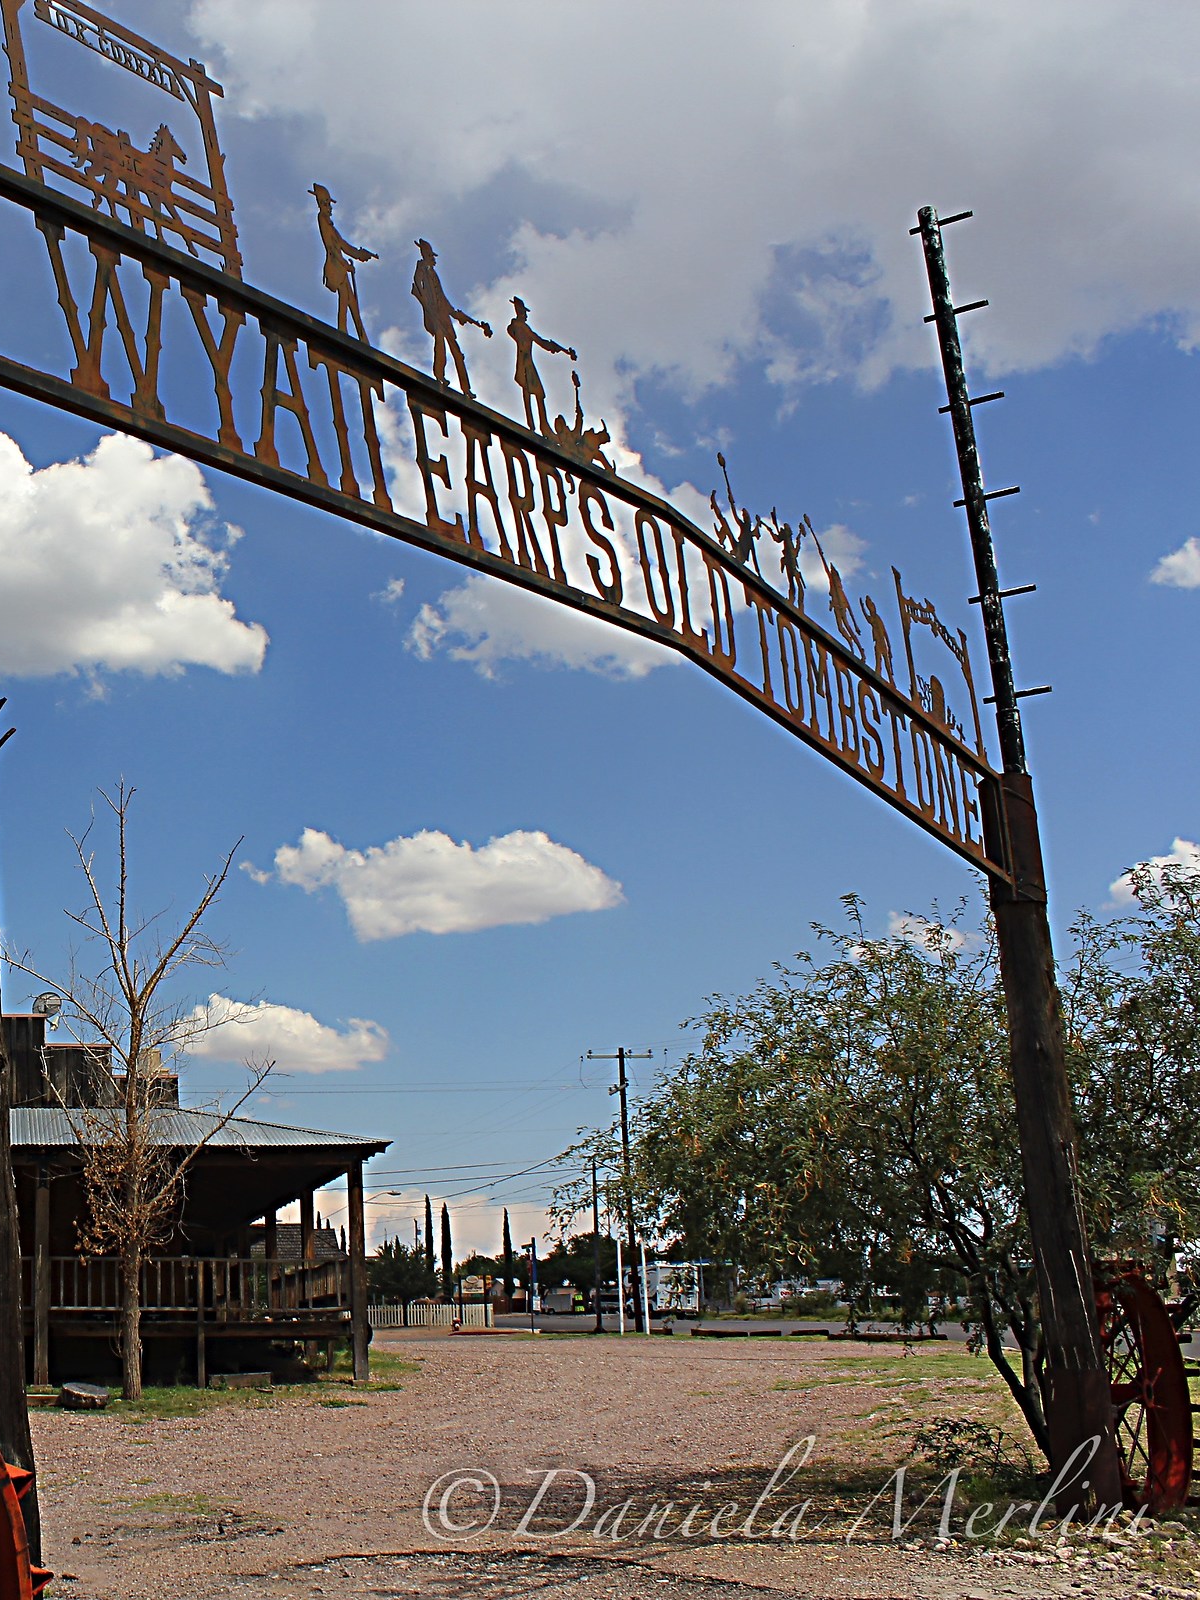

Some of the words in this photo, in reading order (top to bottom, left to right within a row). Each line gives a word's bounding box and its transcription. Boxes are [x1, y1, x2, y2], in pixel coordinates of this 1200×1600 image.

[98, 36, 170, 91] CORRAL
[34, 210, 393, 514] WYATT
[406, 390, 623, 605] EARP'S
[635, 507, 737, 671] OLD
[744, 583, 984, 858] TOMBSTONE
